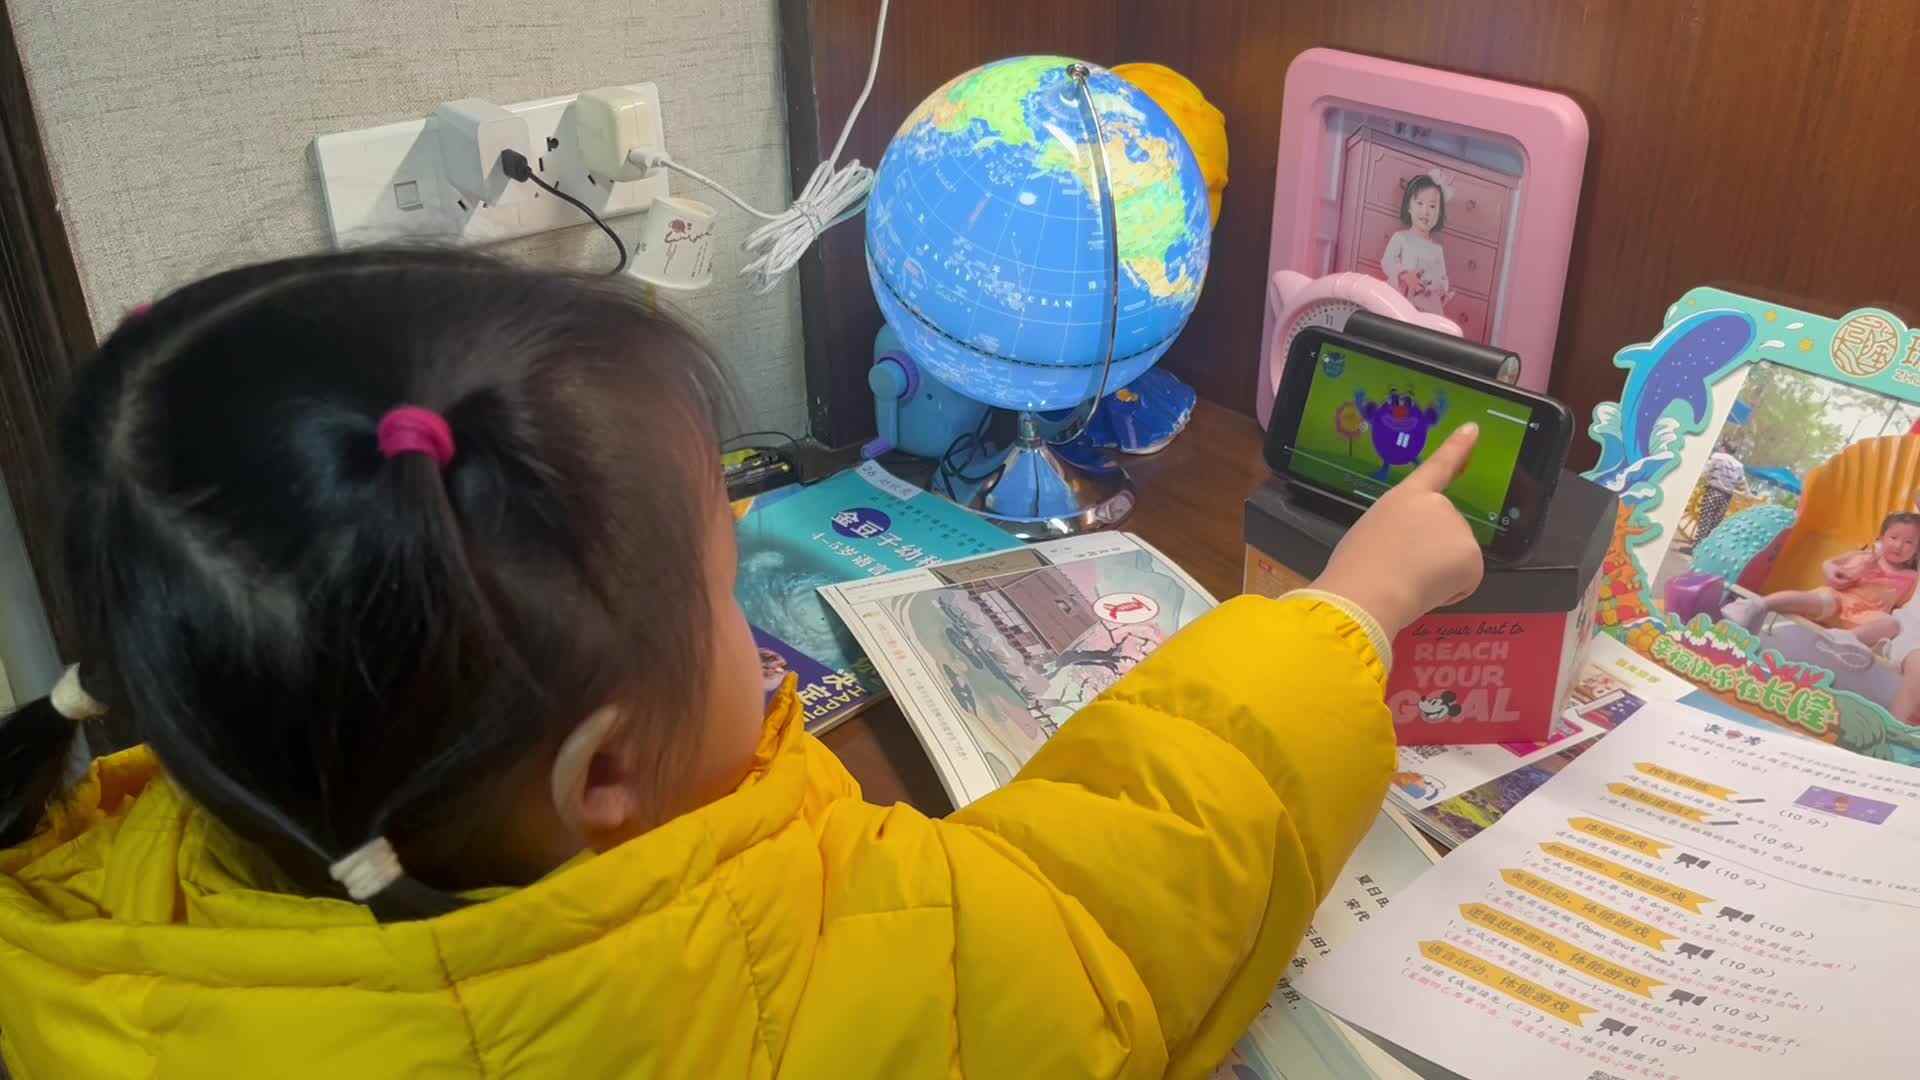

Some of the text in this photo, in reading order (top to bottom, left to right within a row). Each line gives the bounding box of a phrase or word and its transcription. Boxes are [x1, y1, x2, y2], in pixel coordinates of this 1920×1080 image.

[1414, 641, 1510, 661] REACH
[1412, 665, 1505, 688] YOUR
[1651, 636, 1836, 734] 幸福快乐在长隆
